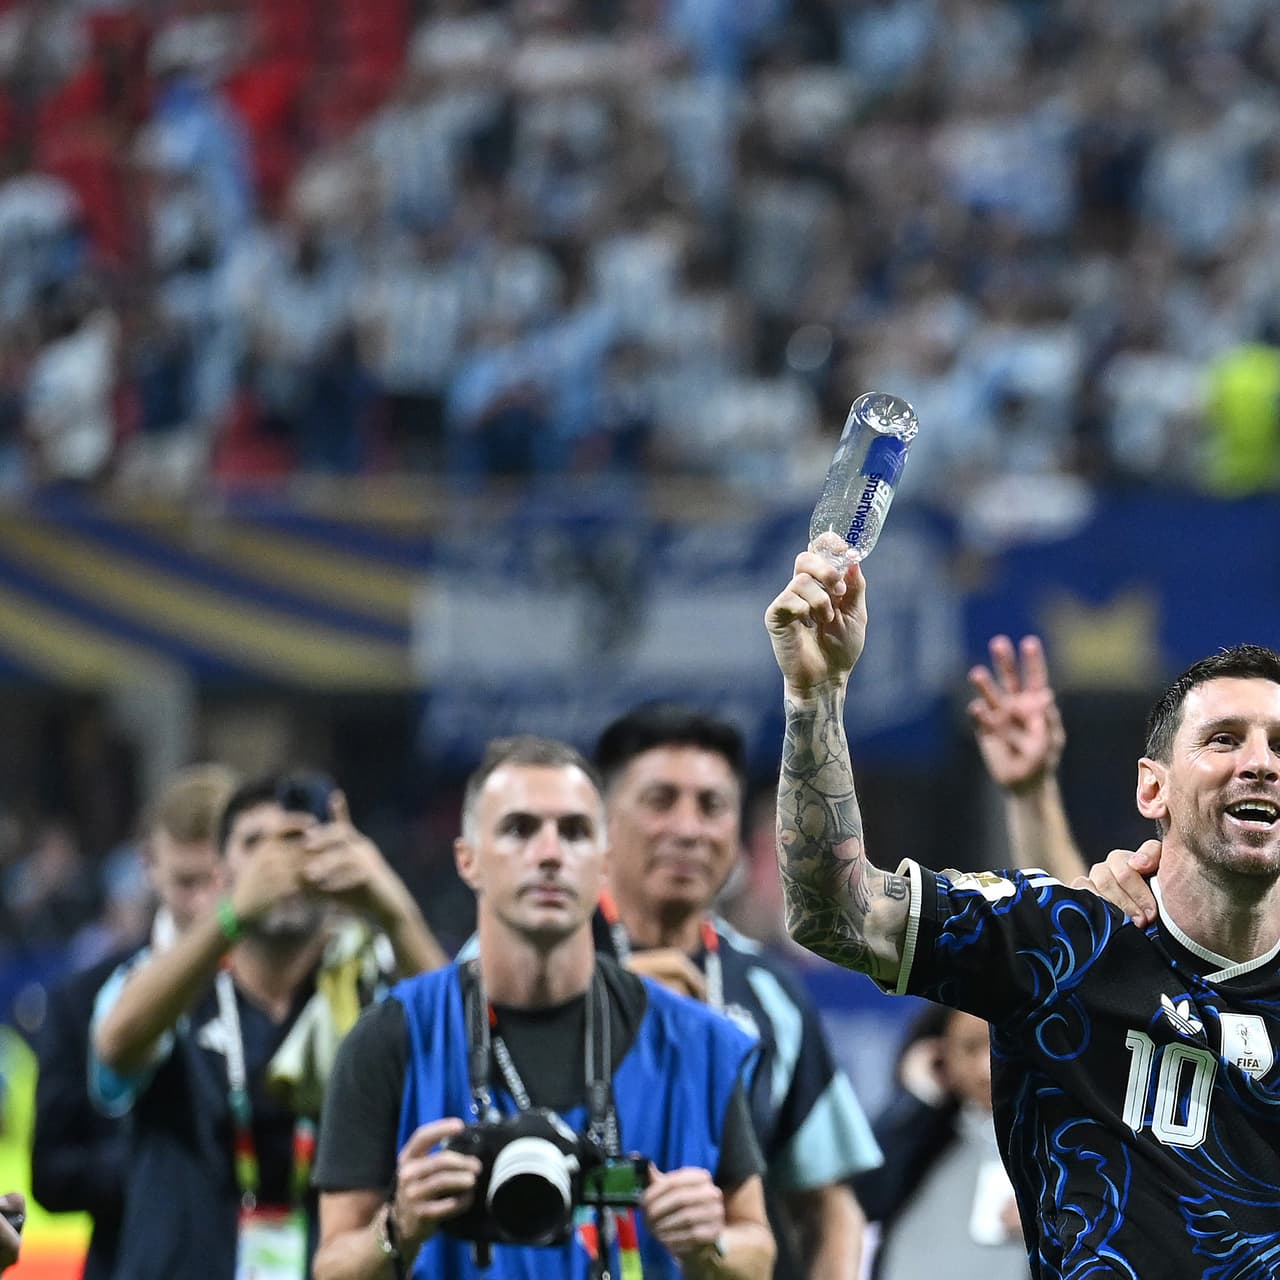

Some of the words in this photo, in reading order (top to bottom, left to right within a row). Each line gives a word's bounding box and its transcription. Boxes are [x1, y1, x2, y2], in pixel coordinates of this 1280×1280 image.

[845, 472, 882, 546] smartwater
[1122, 1029, 1219, 1150] 10
[1236, 1057, 1259, 1068] FIFA
